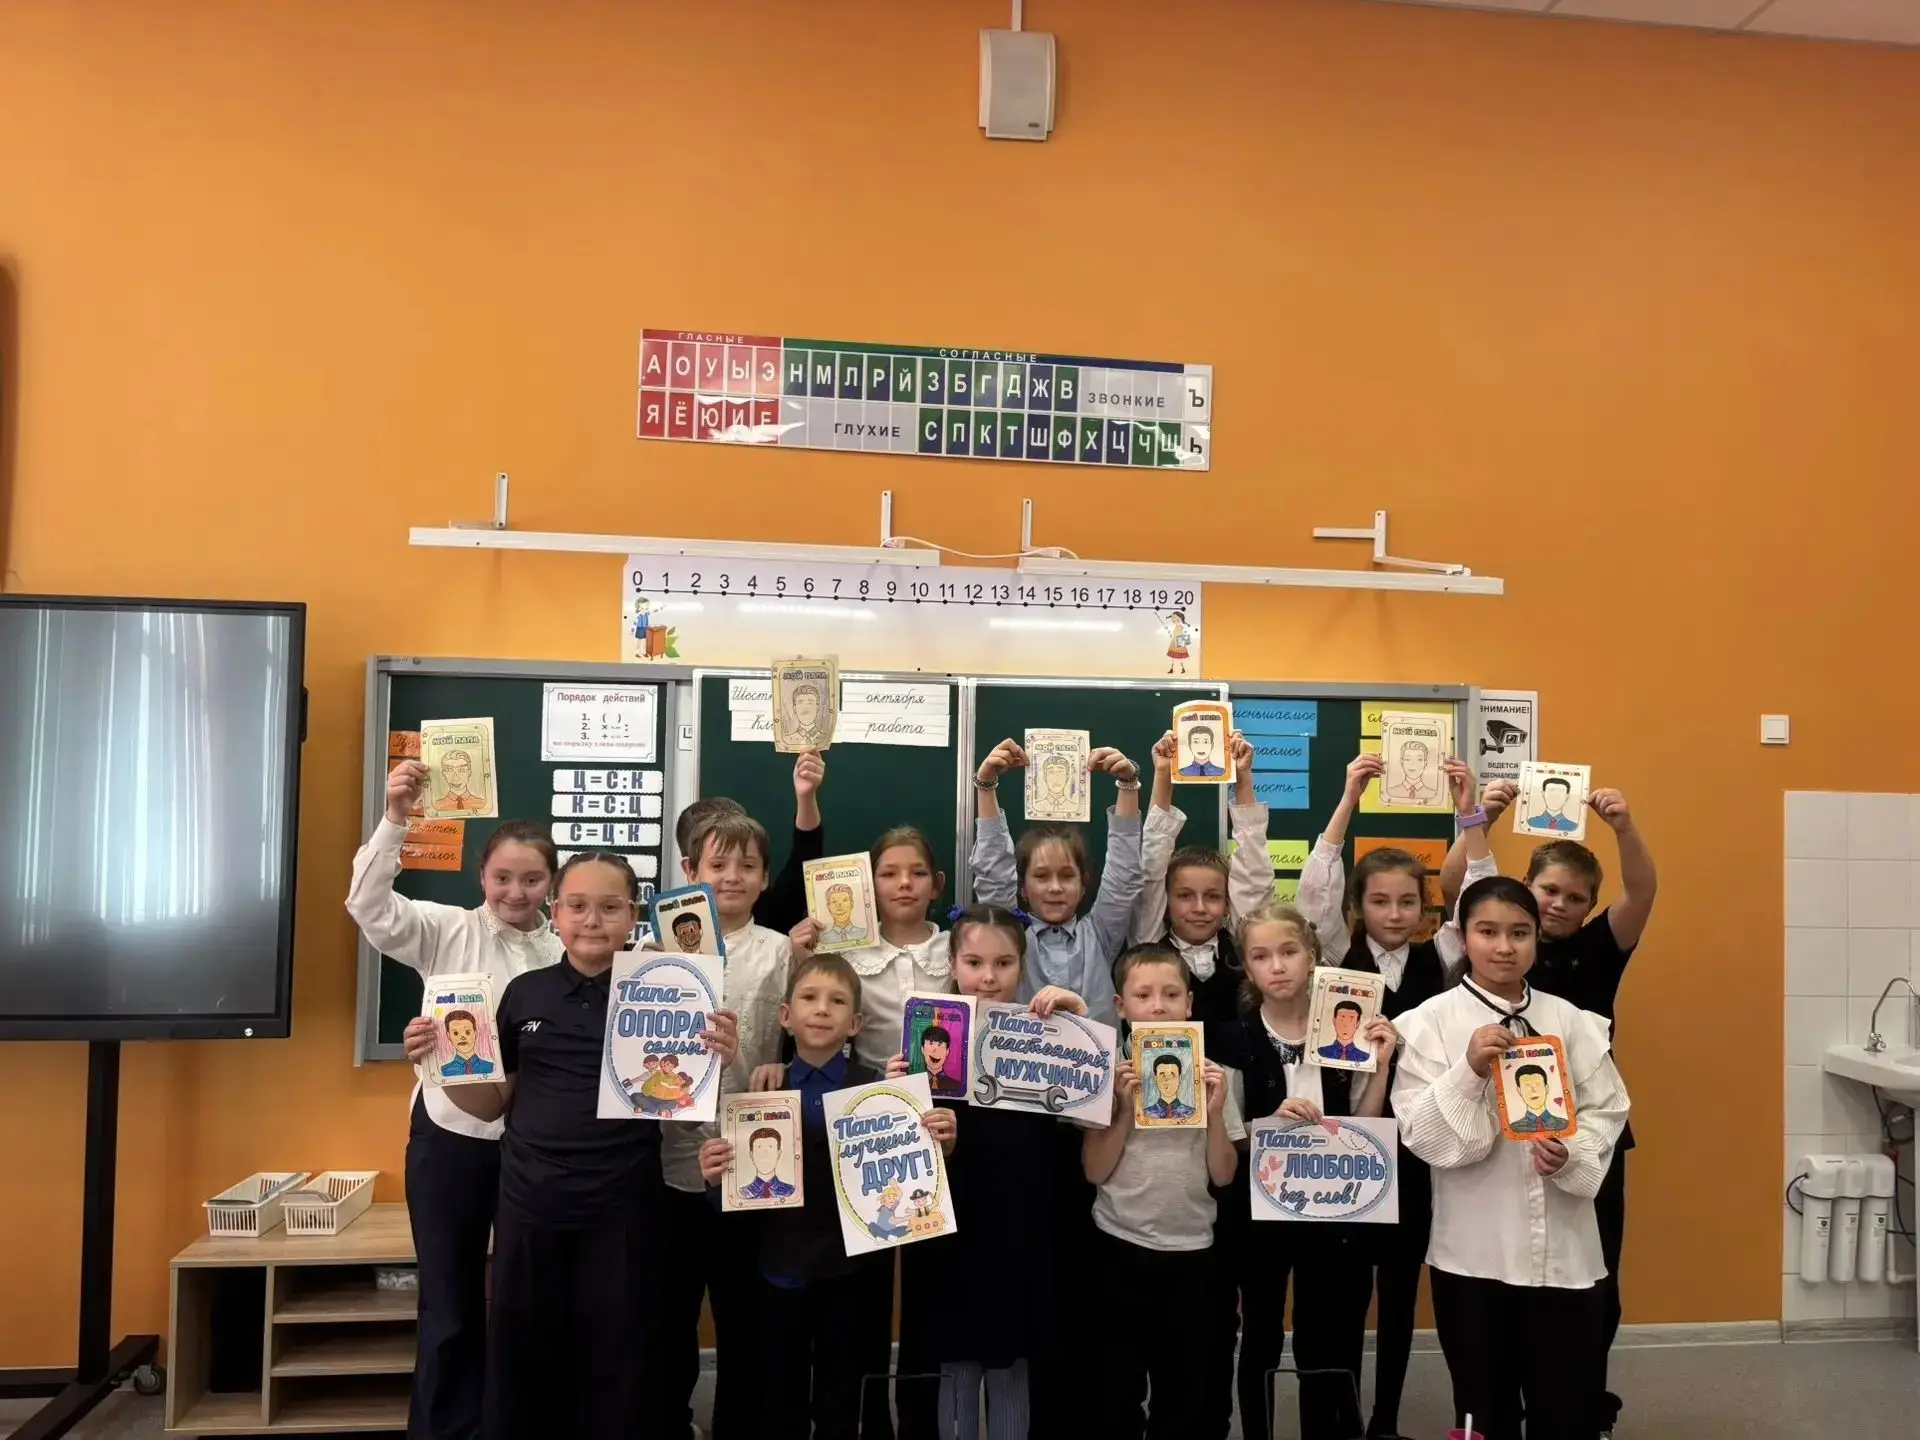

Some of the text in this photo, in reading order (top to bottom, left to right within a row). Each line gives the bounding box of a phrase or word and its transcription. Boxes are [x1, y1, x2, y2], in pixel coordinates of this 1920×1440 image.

[678, 332, 745, 344] ГЛАСНЫЕ
[939, 348, 1038, 363] СОГЛАСНЫЕ
[647, 355, 661, 374] А
[676, 356, 690, 375] О
[706, 358, 717, 377] У
[732, 361, 749, 380] Ы
[762, 362, 774, 381] Э
[790, 364, 802, 383] Н
[817, 365, 831, 384] М
[844, 367, 857, 386] Л
[873, 368, 885, 387] Р
[900, 368, 911, 392] Й
[928, 372, 939, 391] З
[954, 374, 966, 393] Б
[981, 375, 992, 394] Г
[1006, 375, 1021, 398] Д
[1032, 378, 1049, 398] Ж
[1061, 380, 1073, 399] В
[1088, 392, 1165, 408] ЗВОНКИЕ
[646, 404, 659, 424] Я
[675, 401, 687, 425] Ё
[701, 407, 719, 428] Ю
[834, 423, 901, 438] ГЛУХИЕ
[925, 421, 937, 441] С
[953, 423, 964, 442] П
[980, 425, 991, 444] К
[1007, 426, 1018, 445] Т
[1031, 428, 1047, 447] Ш
[1058, 429, 1072, 449] Ф
[1086, 431, 1098, 450] Х
[1113, 431, 1125, 453] Ц
[1139, 433, 1150, 452] Ч
[633, 570, 1194, 606] 0 1 2 3 4 5 6 7 8 9 10 11 12 13 14 15 16 17 18 19 20
[783, 669, 828, 680] МОЙ ПАПА
[557, 692, 645, 703] Порядок действий
[865, 688, 926, 709] октября
[1233, 709, 1316, 720] меньшаемое
[864, 717, 926, 738] работа
[1393, 727, 1437, 737] МОЙ ПАПА
[432, 736, 480, 745] МОЙ ПАПА
[618, 1009, 707, 1039] ОПОРА
[990, 1036, 1110, 1070] настоящий
[994, 1057, 1101, 1095] МУЖЧИНА!
[739, 1110, 762, 1123] МОЙ
[841, 1123, 920, 1168] лучший
[862, 1149, 934, 1196] ДРУГ!
[1284, 1153, 1385, 1181] ЛЮБОВЬ
[1279, 1181, 1363, 1212] без слов!
